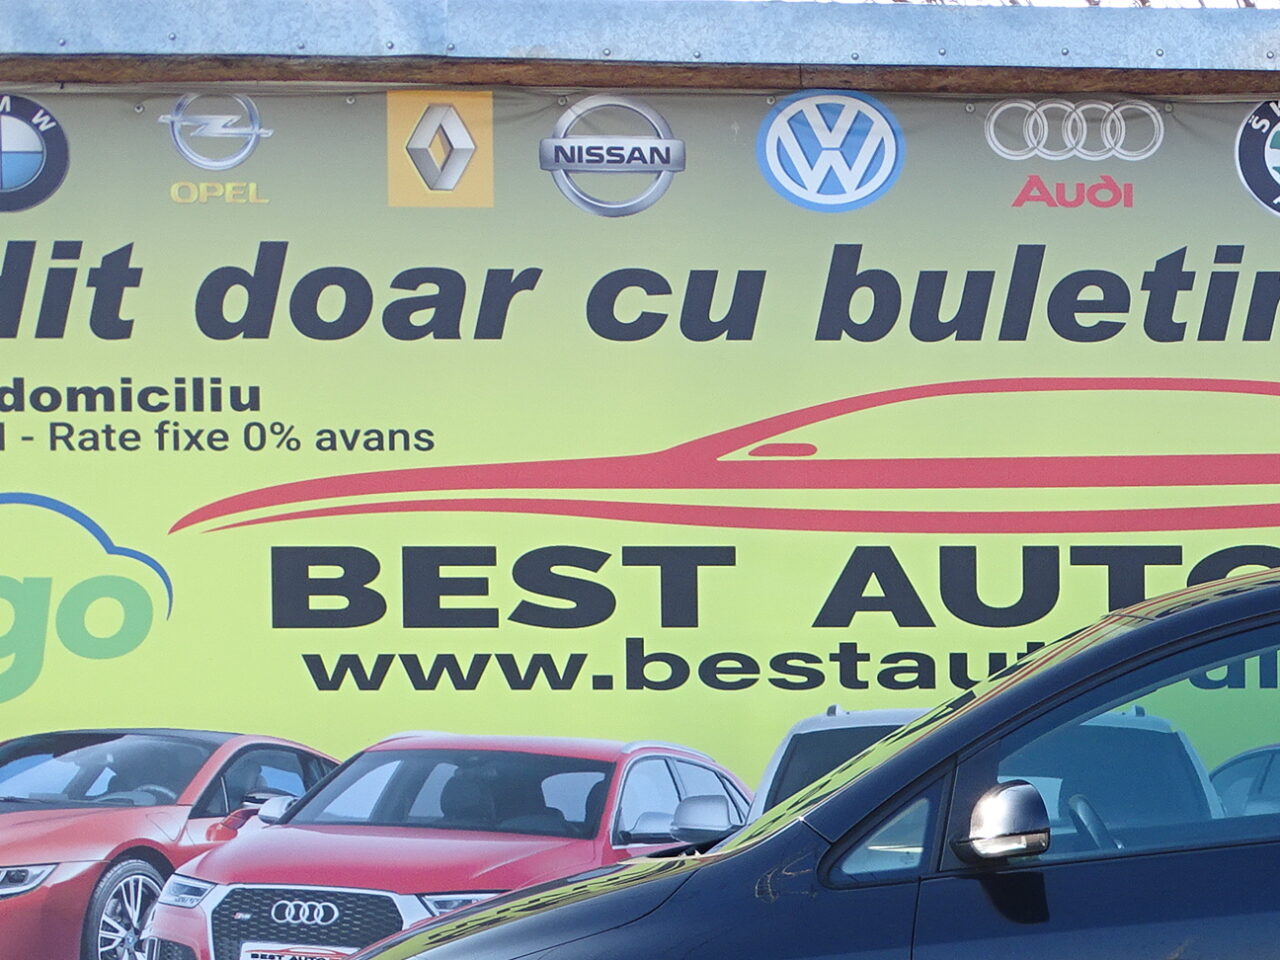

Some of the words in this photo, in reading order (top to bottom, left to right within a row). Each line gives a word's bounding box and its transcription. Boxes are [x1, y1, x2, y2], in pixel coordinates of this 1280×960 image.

[554, 144, 671, 165] NISSAN
[170, 181, 271, 204] OPEL
[1011, 174, 1134, 208] Audi
[194, 240, 543, 342] doar
[585, 267, 767, 343] cu
[0, 376, 261, 413] domiciliu
[49, 422, 142, 452] Rate
[155, 420, 229, 451] fixe
[243, 421, 302, 452] 0%
[315, 428, 435, 452] avans
[271, 545, 737, 629] BEST
[251, 953, 284, 960] BEST
